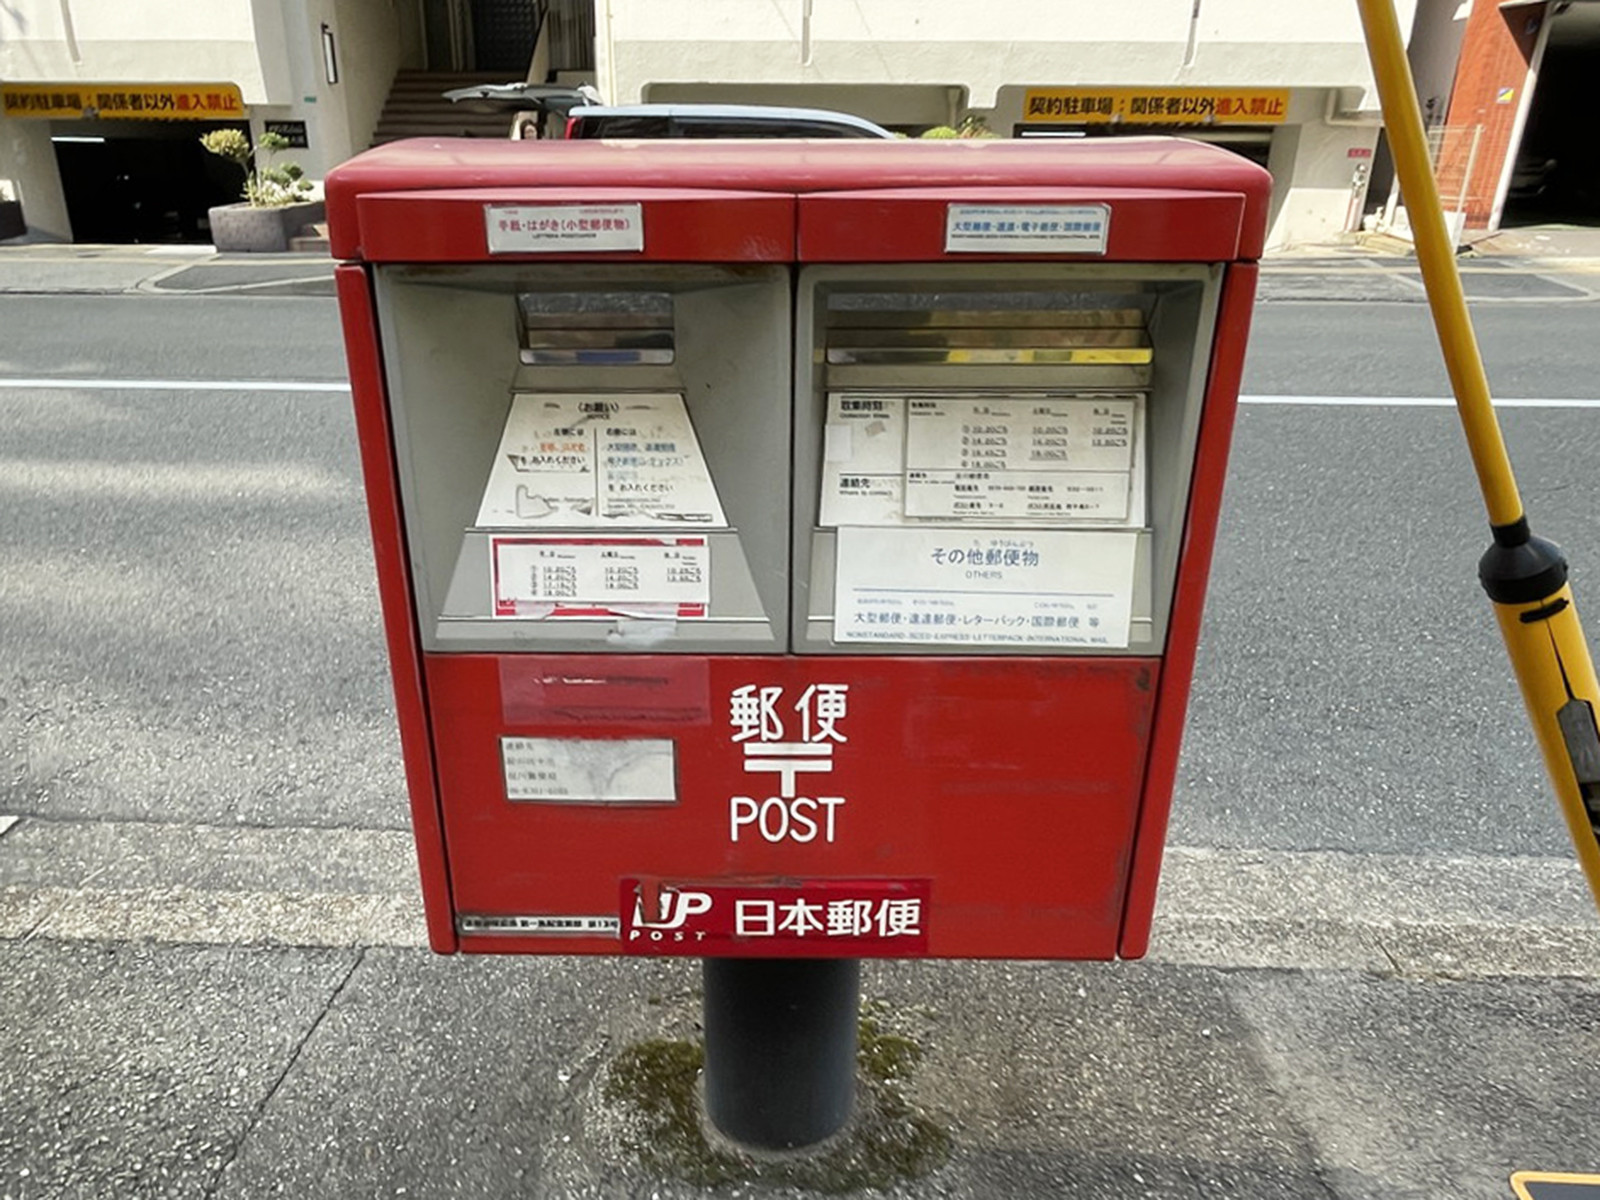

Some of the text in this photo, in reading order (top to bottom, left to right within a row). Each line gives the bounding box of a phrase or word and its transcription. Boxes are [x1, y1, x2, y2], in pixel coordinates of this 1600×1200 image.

[931, 547, 1040, 567] その他郵便物
[965, 570, 1003, 580] OTHERS
[729, 684, 849, 743] 郵便
[730, 796, 846, 843] POST
[735, 898, 921, 937] 日本郵便
[629, 929, 706, 941] POST
